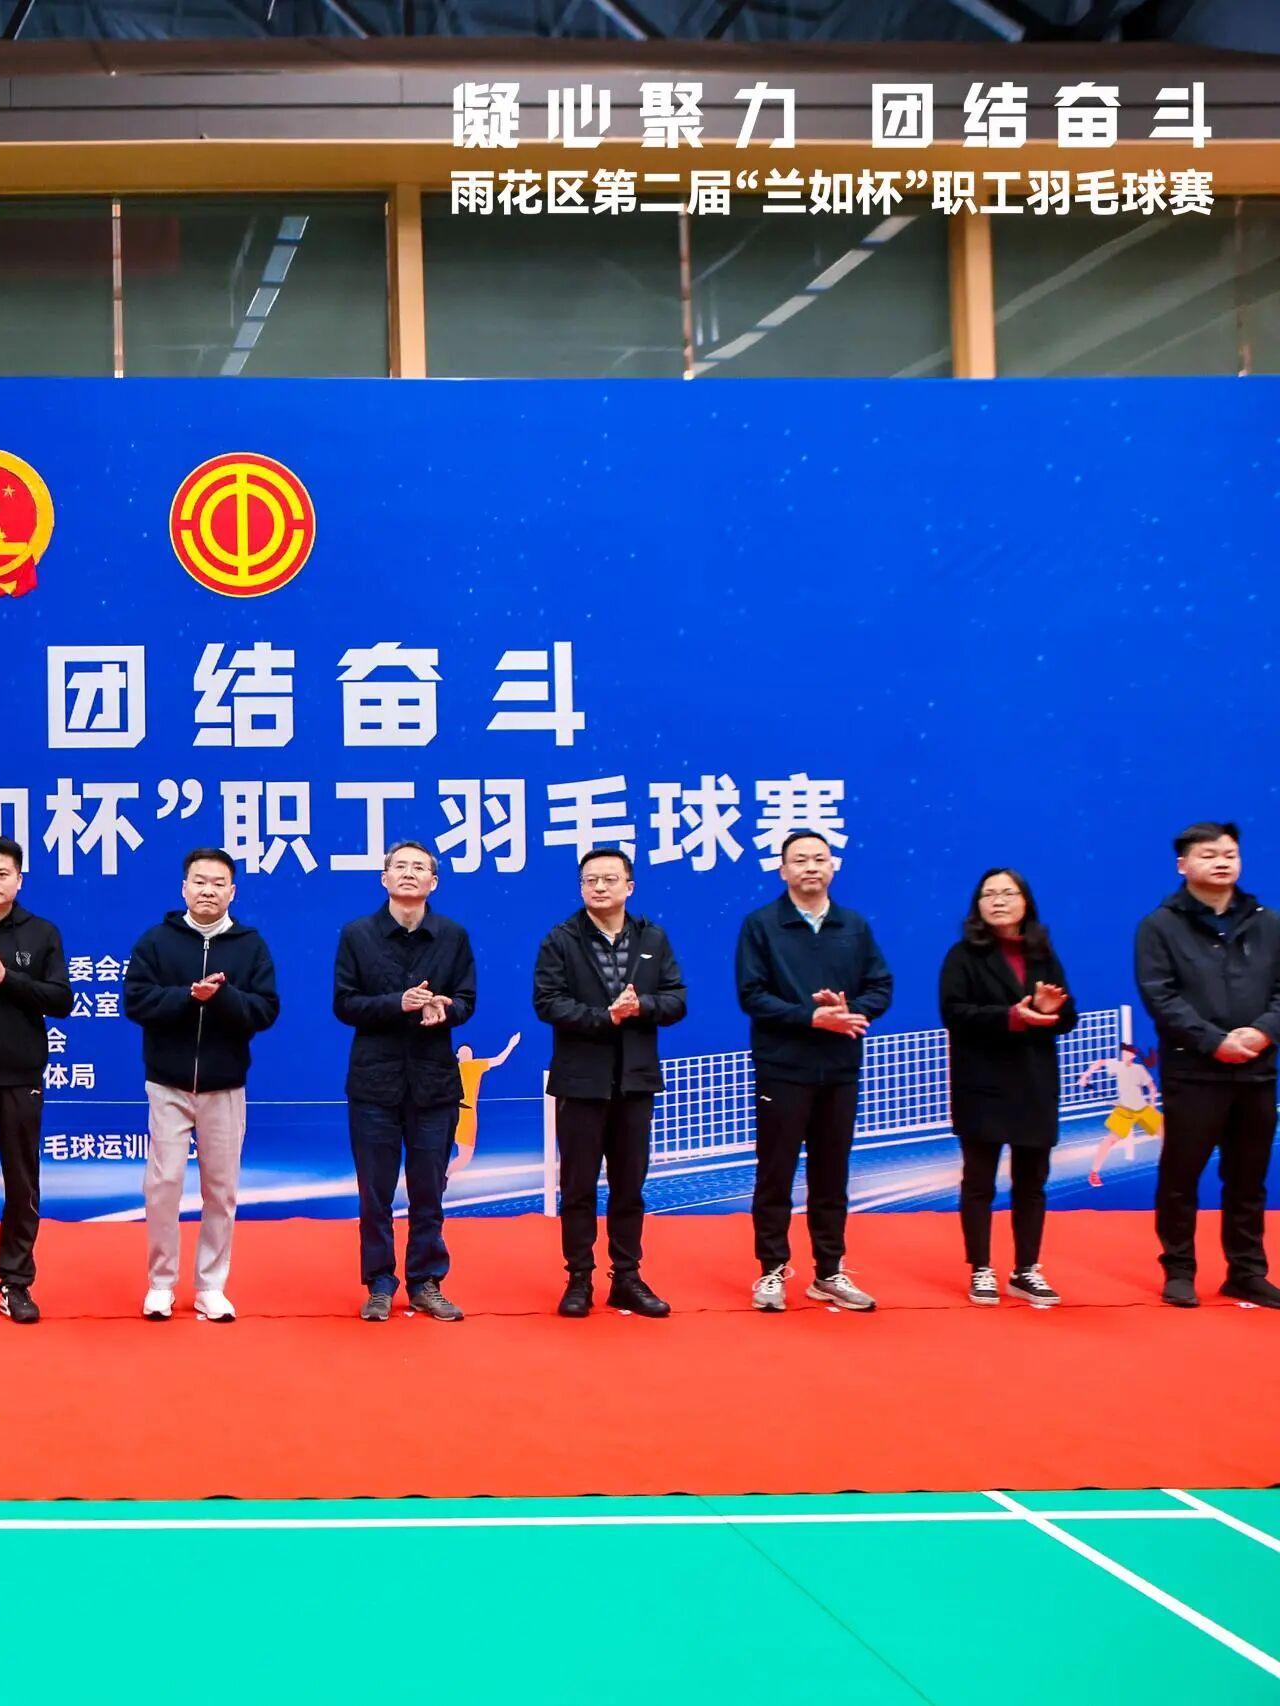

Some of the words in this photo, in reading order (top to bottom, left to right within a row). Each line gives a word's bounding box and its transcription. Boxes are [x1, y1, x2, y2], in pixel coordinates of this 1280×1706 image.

[46, 641, 586, 749] 团结奋斗
[68, 954, 131, 983] 委会
[70, 991, 120, 1018] 公室
[42, 1062, 96, 1090] 体局
